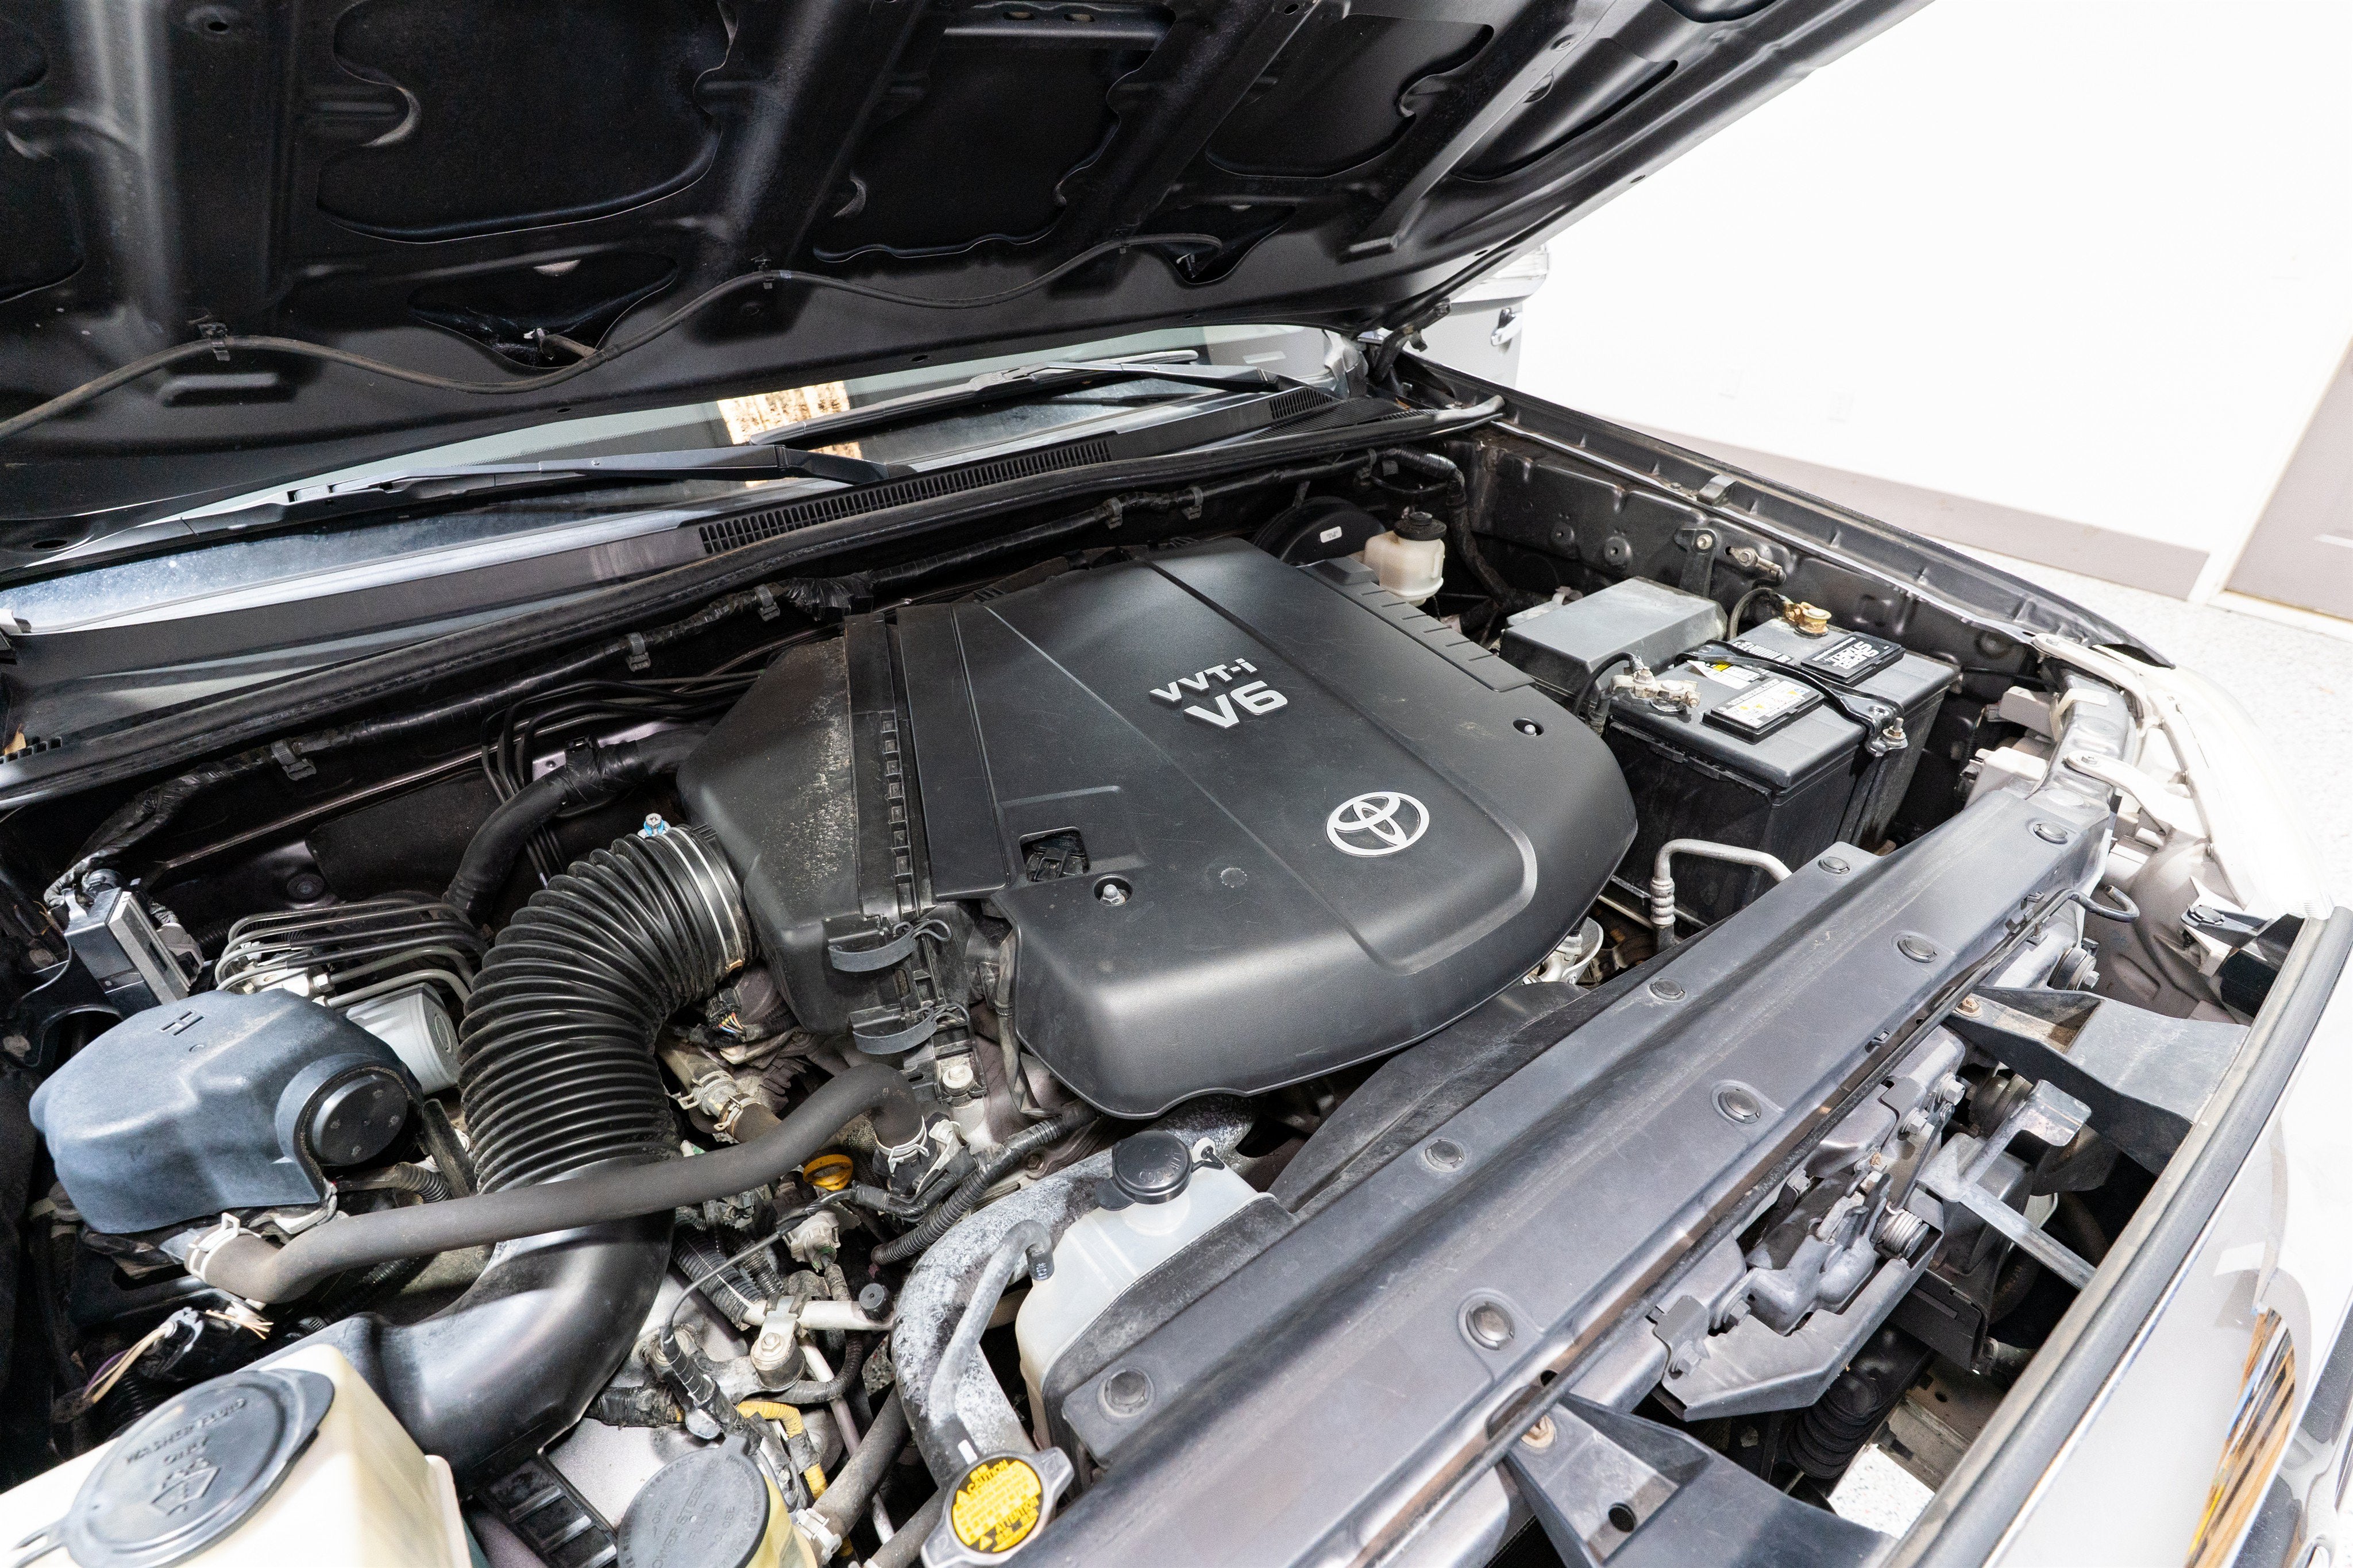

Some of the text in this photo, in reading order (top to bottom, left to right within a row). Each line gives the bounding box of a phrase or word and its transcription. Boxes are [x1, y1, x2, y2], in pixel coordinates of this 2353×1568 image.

[1150, 658, 1257, 702] VVT-i
[1183, 680, 1288, 729] V6
[1139, 1150, 1183, 1184] COOLANT
[967, 1459, 1009, 1493] CAUTION
[995, 1495, 1040, 1534] ATTENTION
[651, 1526, 680, 1568] OWER
